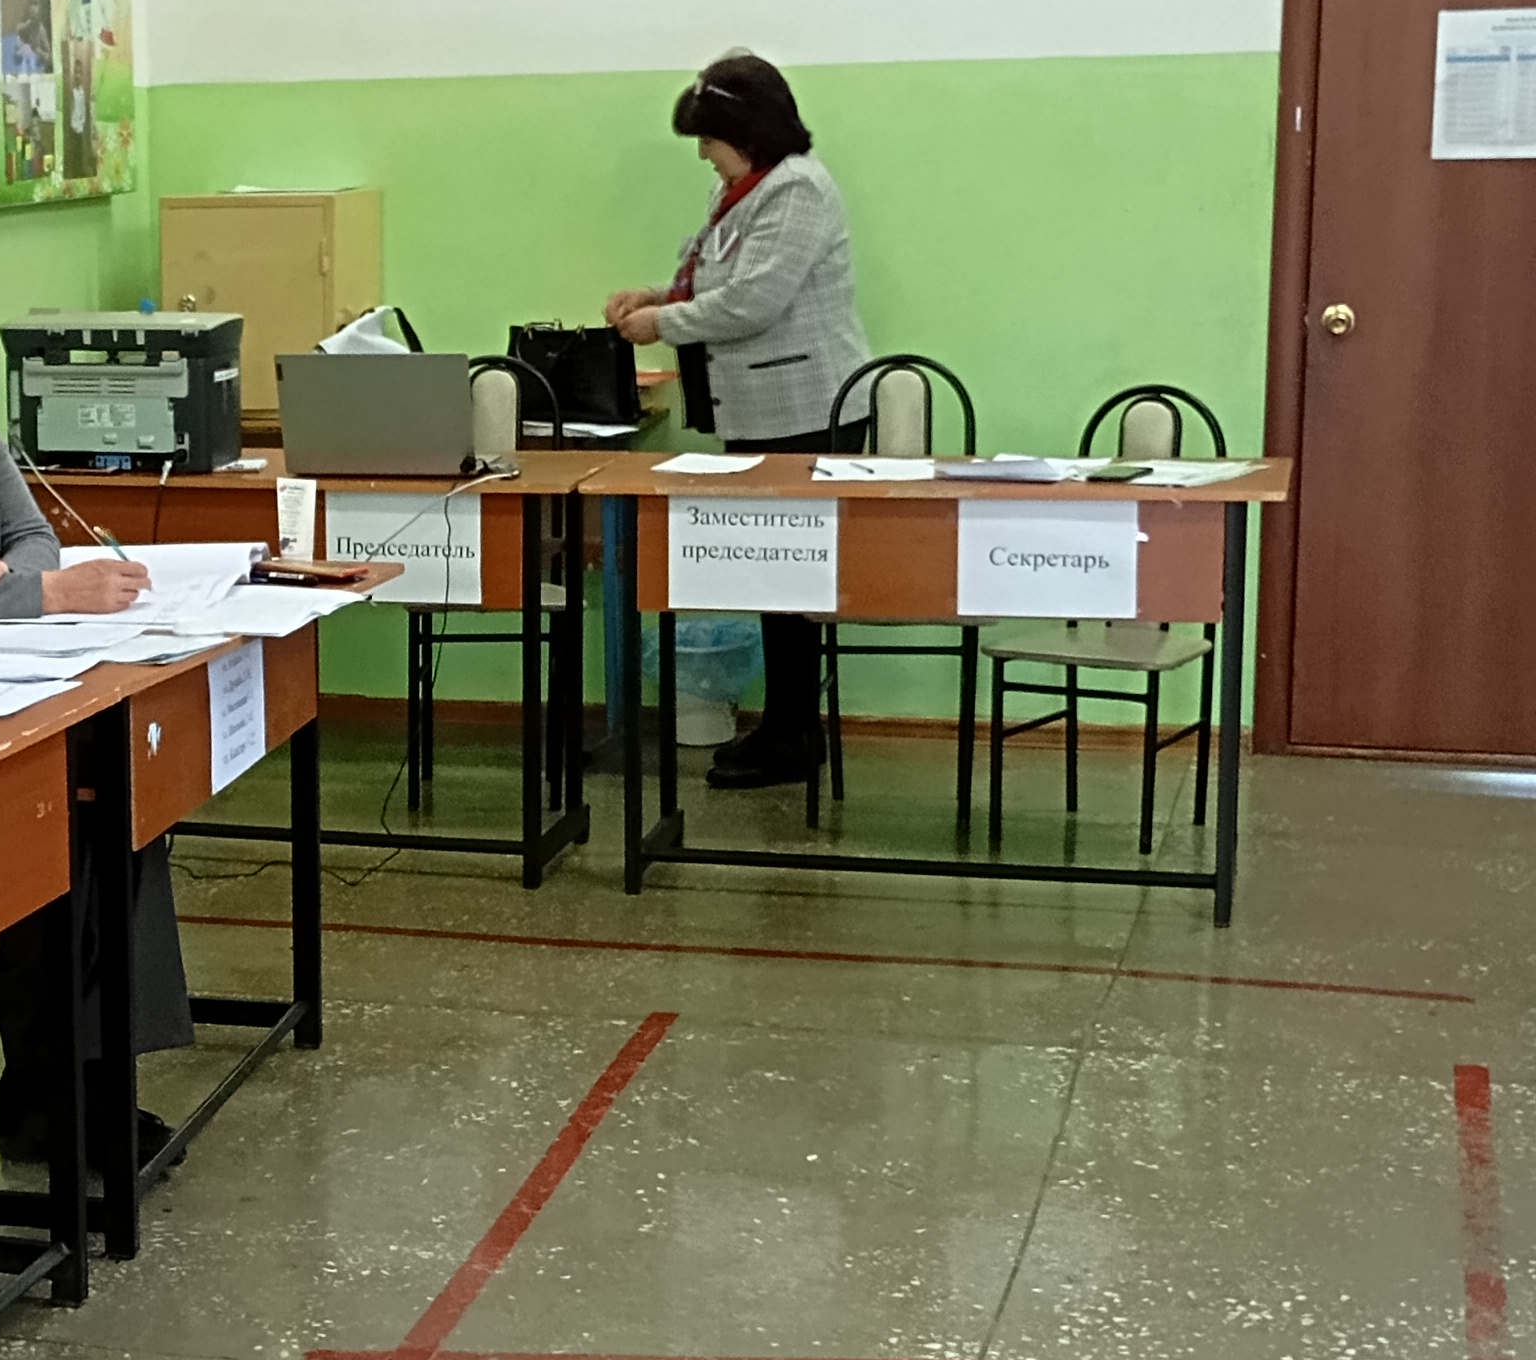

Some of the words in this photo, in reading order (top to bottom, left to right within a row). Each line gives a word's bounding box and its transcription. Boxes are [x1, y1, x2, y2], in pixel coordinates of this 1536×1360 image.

[686, 506, 825, 528] Заместитель
[336, 536, 476, 560] Председатель
[681, 544, 829, 563] председателя
[989, 546, 1110, 573] Секретарь
